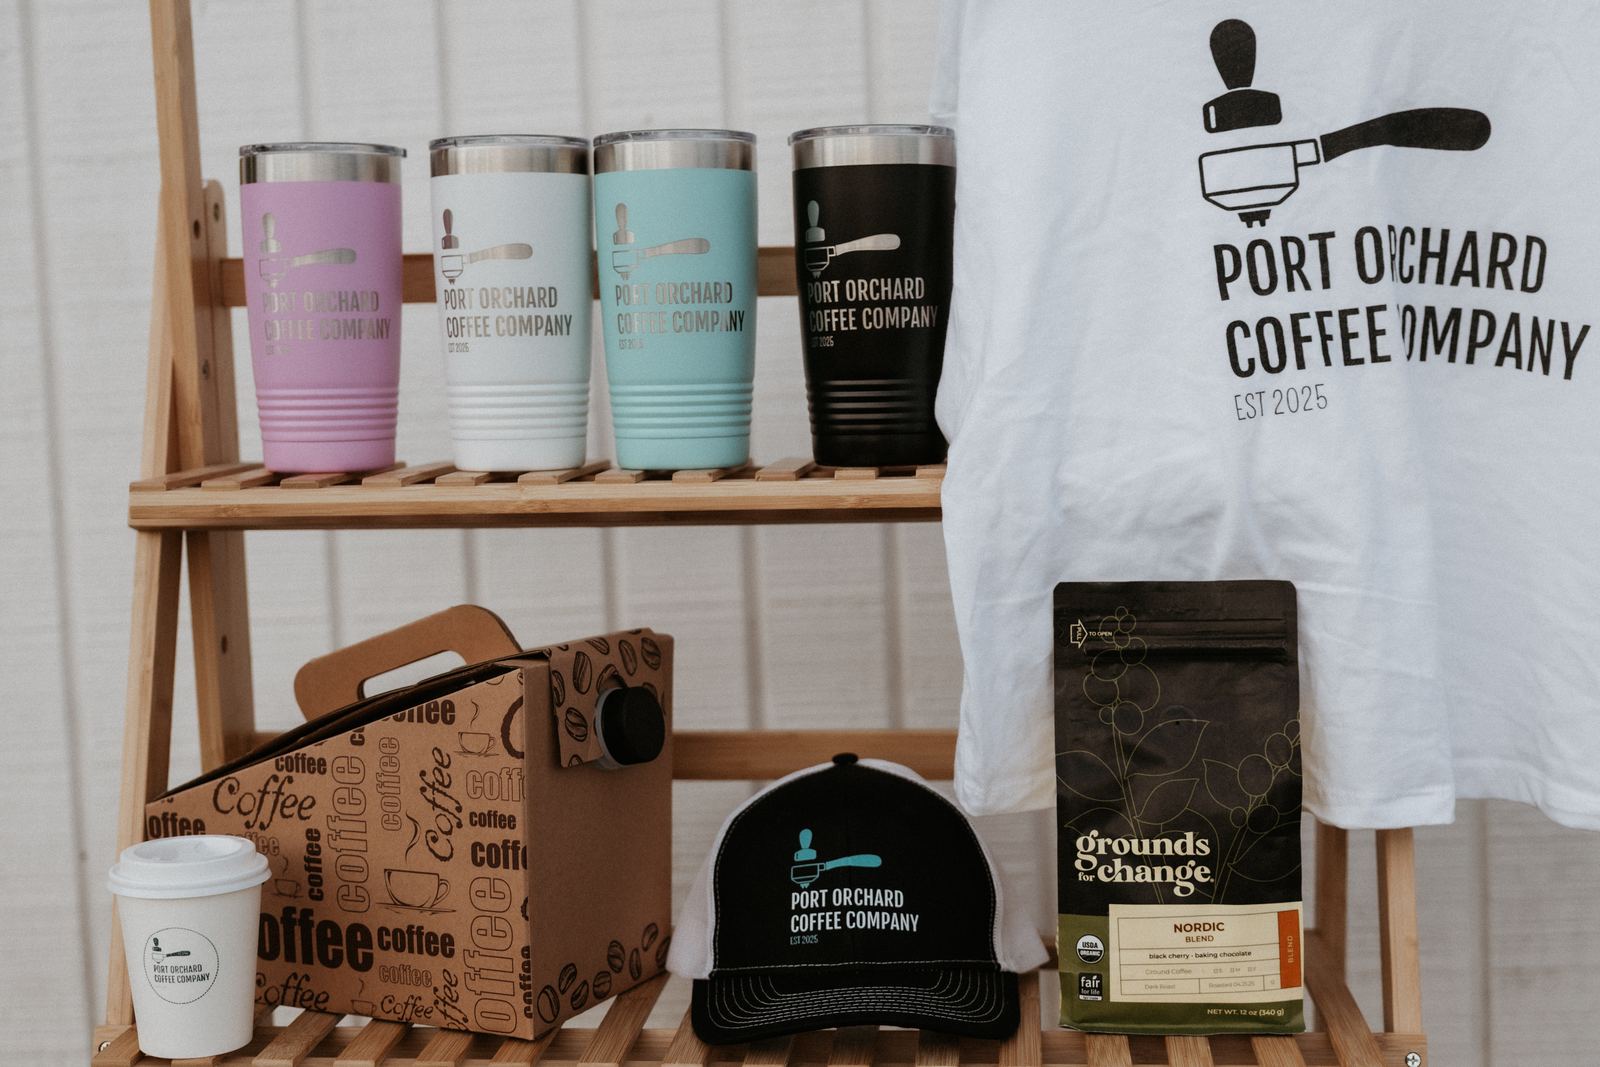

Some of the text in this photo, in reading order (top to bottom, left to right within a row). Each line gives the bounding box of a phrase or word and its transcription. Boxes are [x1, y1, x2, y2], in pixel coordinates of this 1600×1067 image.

[1213, 224, 1547, 301] PORT ORCHARD
[262, 290, 379, 313] PORT ORCHARD
[444, 286, 557, 310] PORT ORCHARD
[616, 281, 733, 306] PORT ORCHARD
[808, 277, 925, 304] PORT ORCHARD
[320, 318, 391, 340] COMPANY
[446, 314, 572, 338] COFFEE COMPANY
[617, 310, 745, 335] COFFEE COMPANY
[809, 305, 938, 333] COFFEE COMPANY
[1225, 303, 1591, 380] COFFEE OMPANY
[1234, 383, 1328, 421] EST 2025
[274, 753, 327, 775] coffee
[376, 736, 402, 832] coffee
[465, 767, 526, 802] coff
[212, 774, 316, 831] Coffee
[419, 746, 463, 862] Coffee
[148, 812, 206, 838] offee
[469, 810, 517, 830] coffee
[327, 755, 371, 914] coffee
[1074, 829, 1211, 872] grounds
[304, 828, 324, 901] coffee
[1078, 872, 1095, 882] for
[791, 887, 904, 910] PORT ORCHARD
[790, 910, 919, 933] COFFEE COMPANY
[1173, 922, 1225, 933] NORDIC
[258, 906, 374, 972] offee
[377, 924, 456, 959] coffee
[790, 934, 819, 945] EST 2025
[1081, 941, 1098, 949] USDA
[1185, 935, 1214, 943] BLEND
[463, 876, 517, 1034] offee
[153, 964, 203, 974] PORT ORCHARD
[154, 972, 210, 983] COFFEE COMPANY
[378, 963, 432, 988] coffee
[1081, 975, 1100, 988] fair
[380, 994, 434, 1021] Coffee
[1259, 1008, 1275, 1016] (340
[1276, 1008, 1284, 1017] g)
